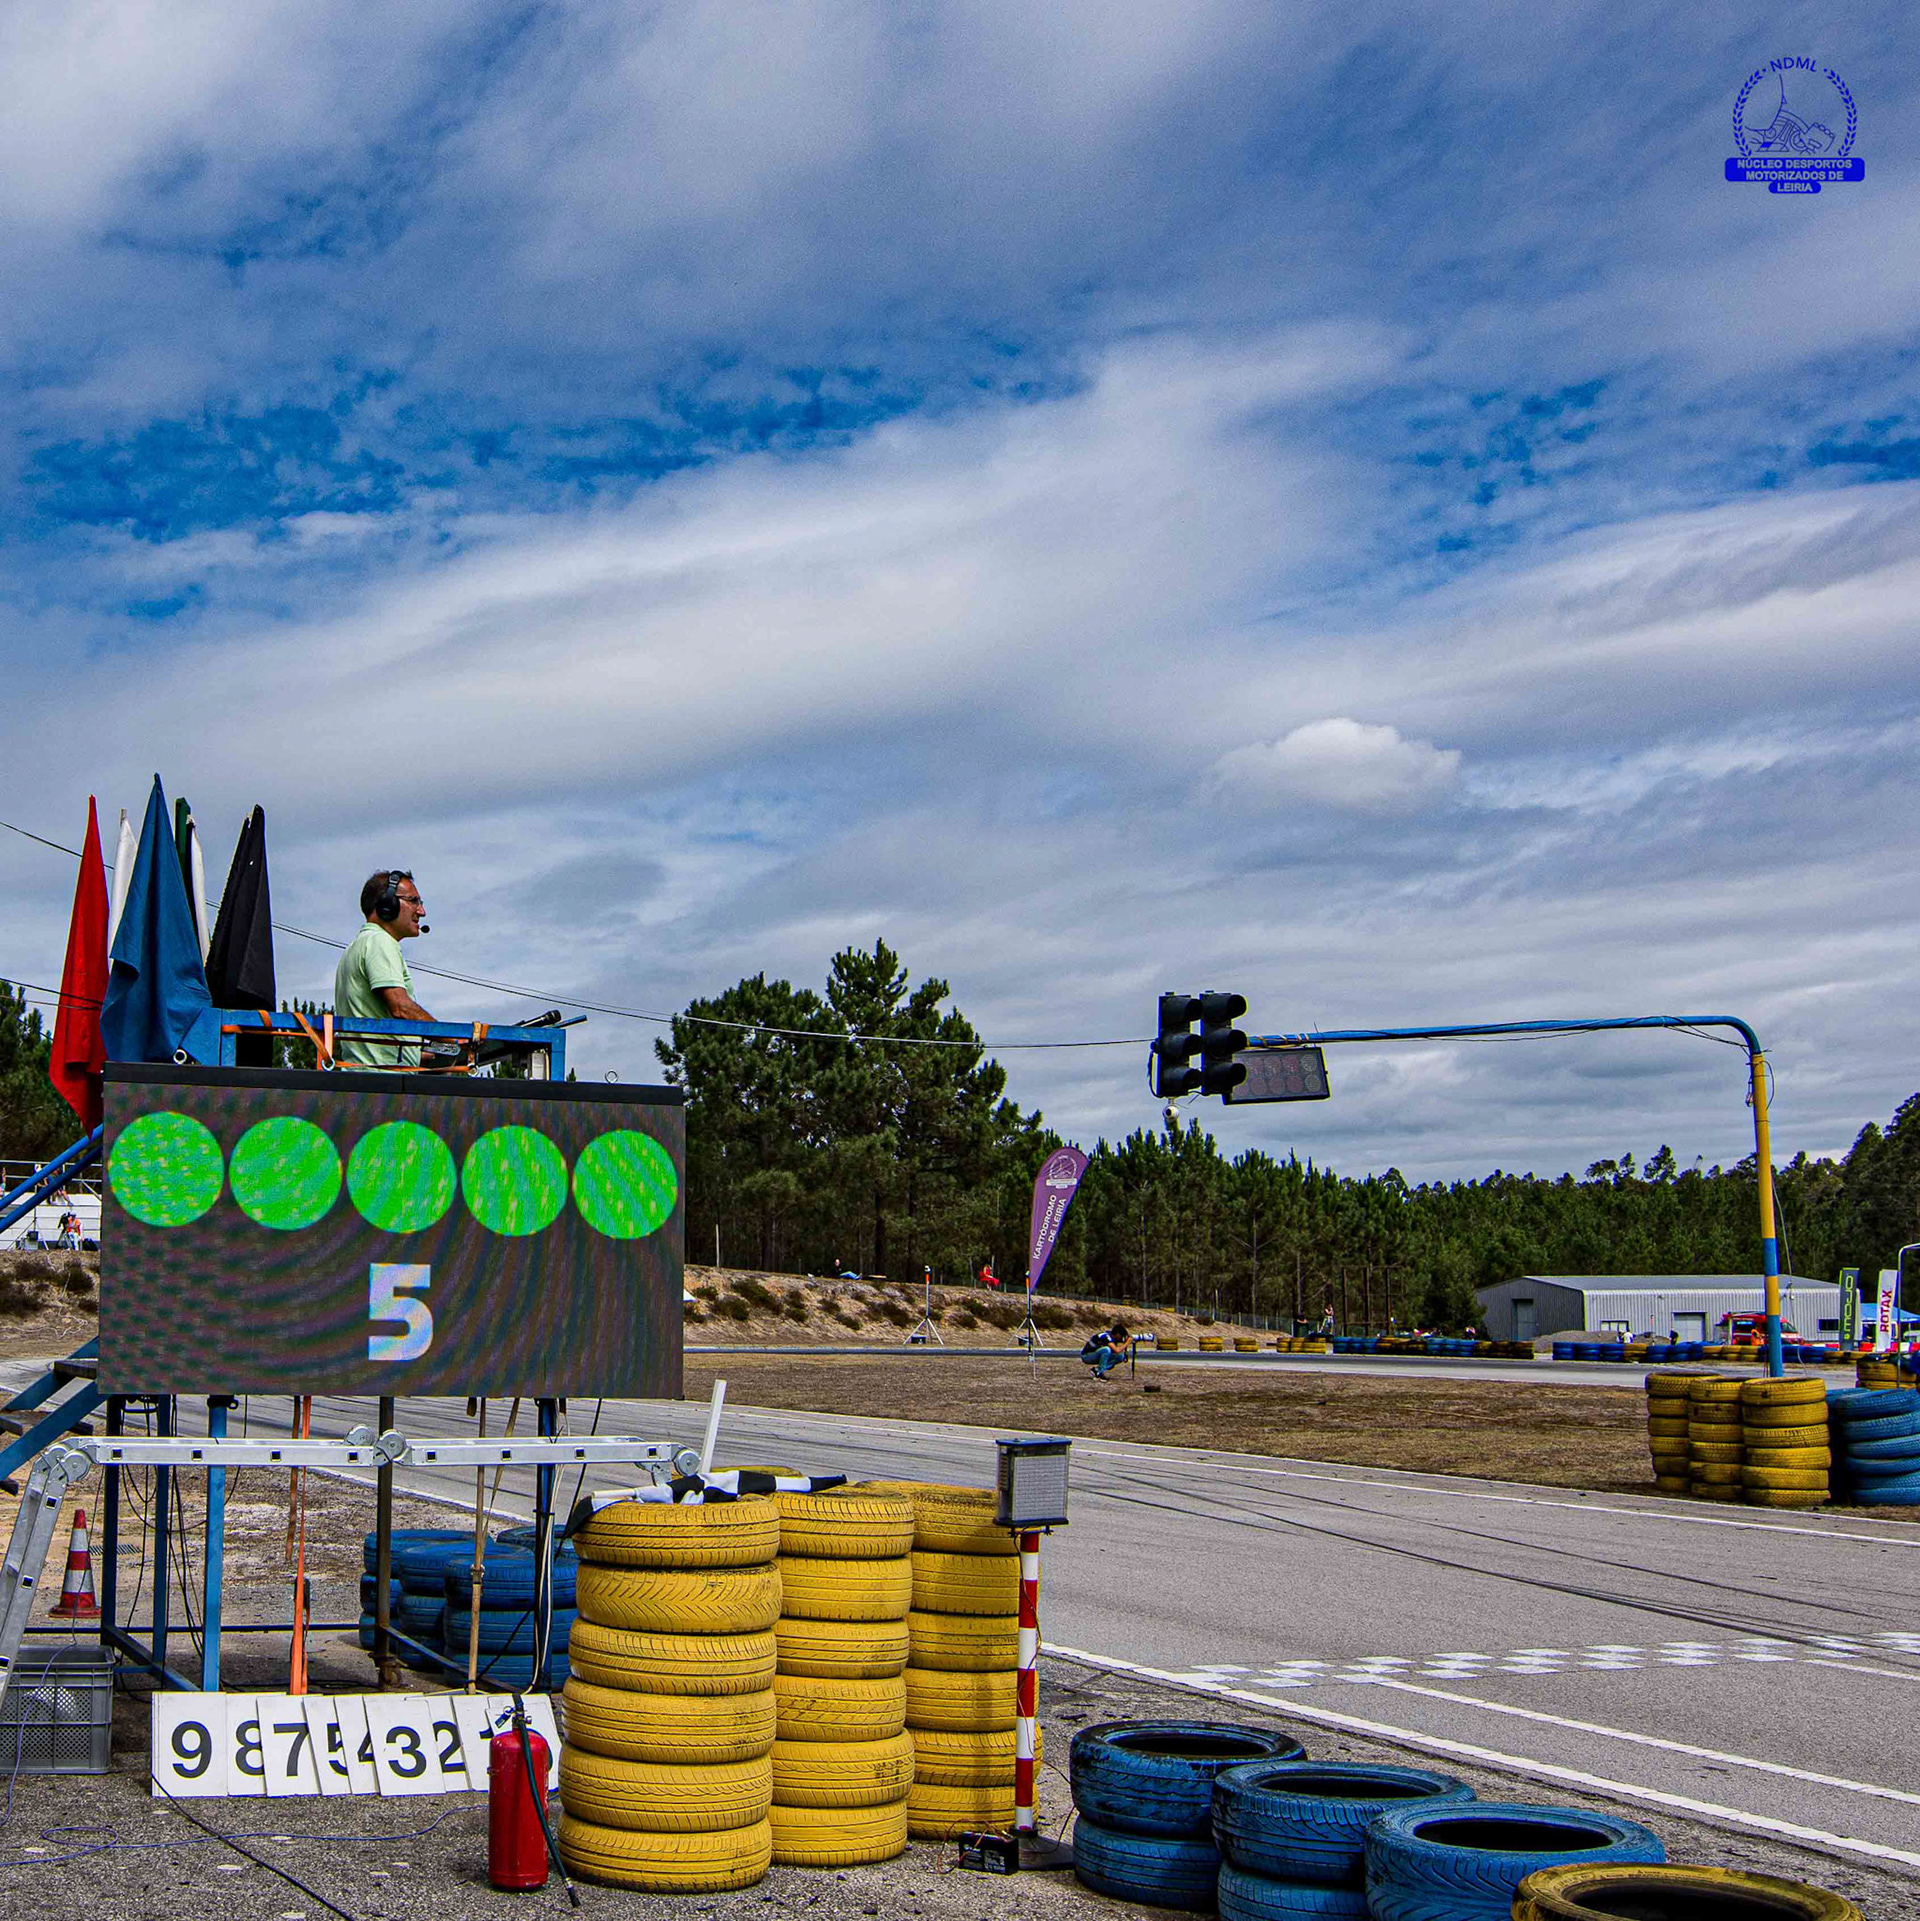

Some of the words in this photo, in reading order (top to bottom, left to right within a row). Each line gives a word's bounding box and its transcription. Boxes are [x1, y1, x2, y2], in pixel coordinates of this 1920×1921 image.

[1033, 1194, 1057, 1259] KARTÓDROMO
[1048, 1229, 1057, 1243] DE
[1053, 1198, 1067, 1227] LEIRIA
[367, 1262, 434, 1362] 5
[1880, 1290, 1892, 1333] ROTAX
[171, 1720, 212, 1779] 9
[235, 1720, 264, 1777] 8
[273, 1723, 309, 1778] 7
[386, 1725, 427, 1779] 3
[433, 1720, 466, 1773] 2
